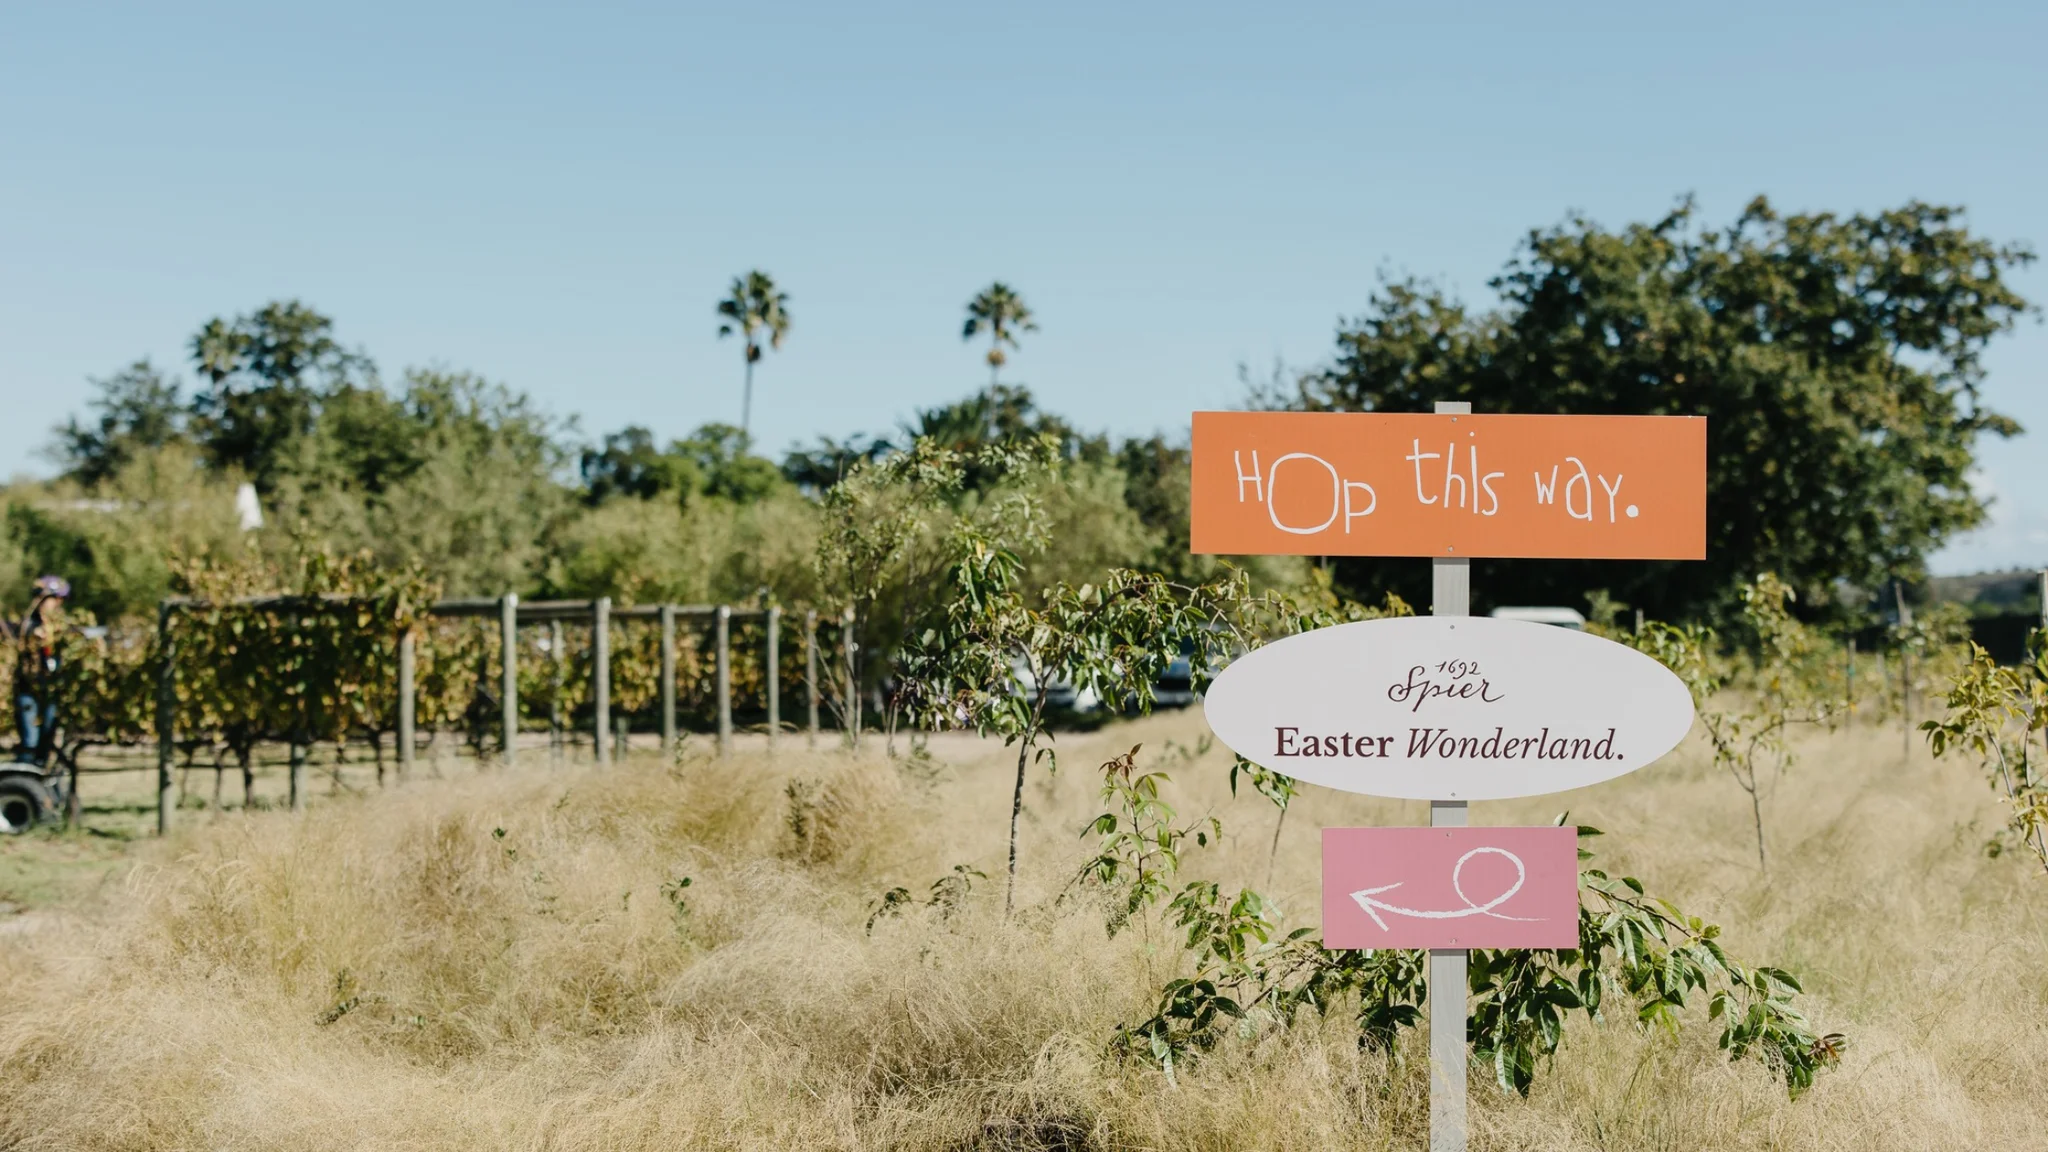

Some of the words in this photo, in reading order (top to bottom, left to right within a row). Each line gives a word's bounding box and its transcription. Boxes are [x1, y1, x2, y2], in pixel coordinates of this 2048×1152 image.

[1405, 431, 1505, 516] this
[1534, 456, 1640, 524] way.
[1387, 665, 1505, 713] Spier
[1435, 658, 1481, 680] 1692
[1273, 726, 1395, 758] Easter
[1406, 726, 1624, 761] Wonderland.
